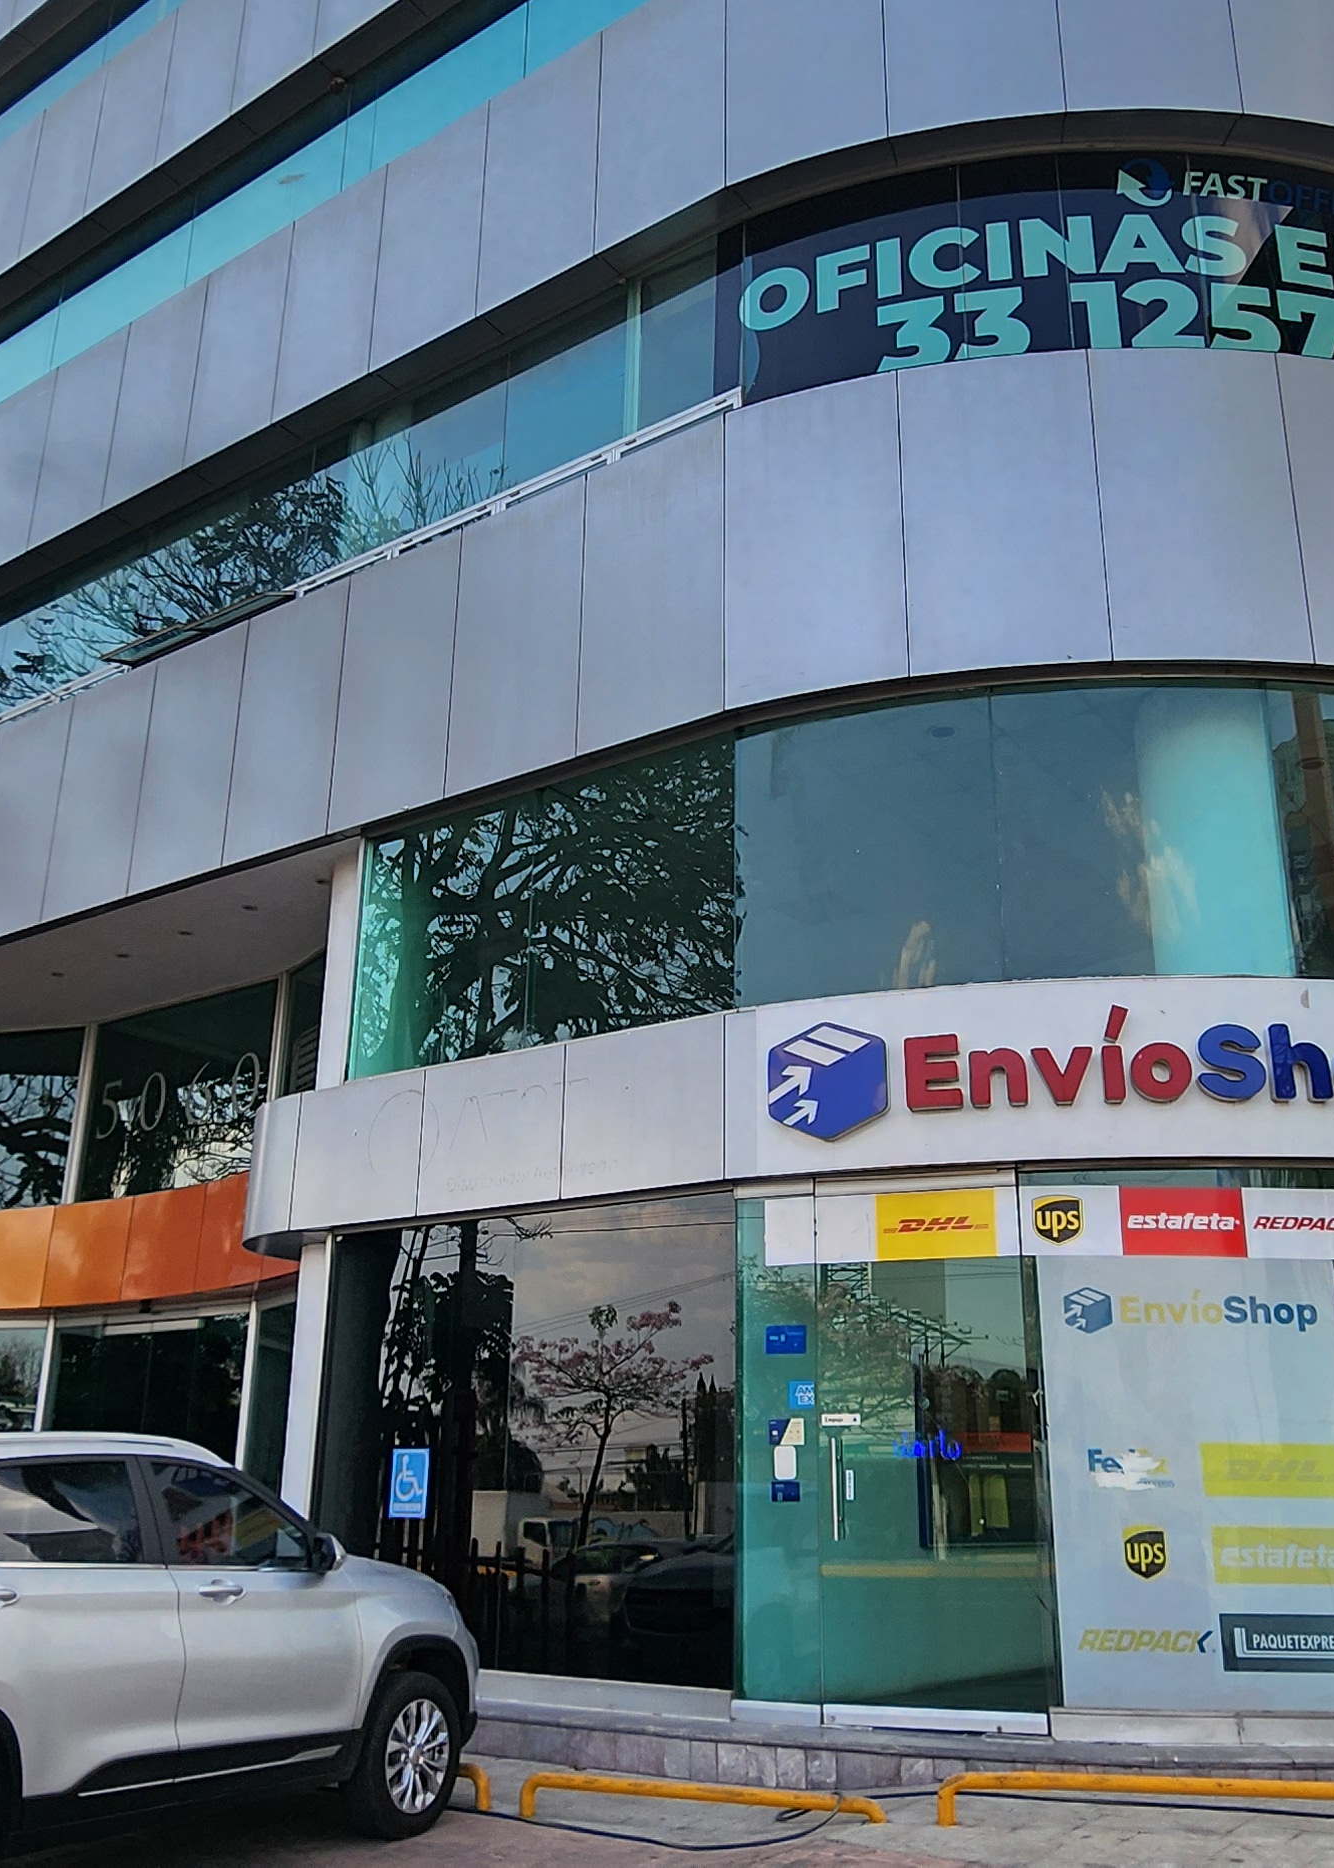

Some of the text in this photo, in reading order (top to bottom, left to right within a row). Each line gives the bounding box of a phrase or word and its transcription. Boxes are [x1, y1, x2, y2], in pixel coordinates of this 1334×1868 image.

[739, 213, 1247, 331] OFICINAS
[877, 286, 1031, 373] 33
[96, 1052, 260, 1140] 5060
[896, 1216, 975, 1233] DHL
[1037, 1210, 1080, 1238] ups
[1127, 1212, 1237, 1231] estafeta
[1119, 1289, 1318, 1332] EnvíoShop
[1126, 1542, 1164, 1572] ups
[1078, 1629, 1214, 1653] REDPACK
